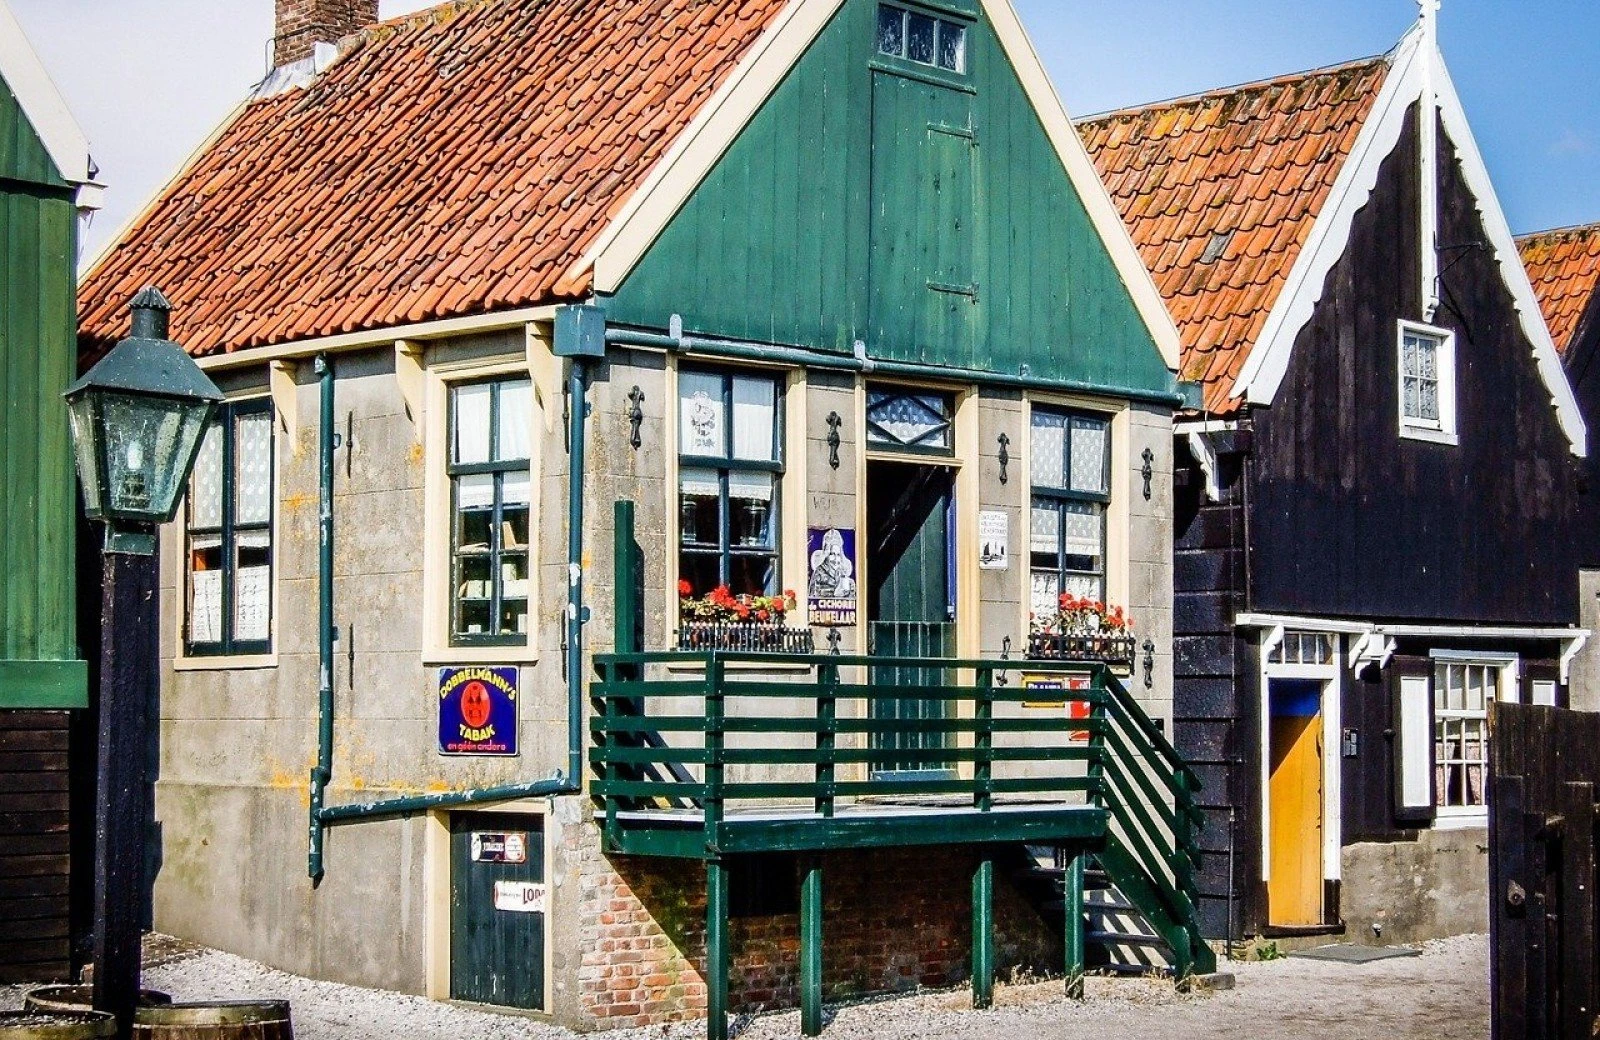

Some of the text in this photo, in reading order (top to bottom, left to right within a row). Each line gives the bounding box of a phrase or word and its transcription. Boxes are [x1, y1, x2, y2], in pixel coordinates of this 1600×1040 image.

[440, 668, 516, 700] DOBBELMANN'S
[459, 723, 496, 741] TABAK
[477, 739, 506, 751] andere
